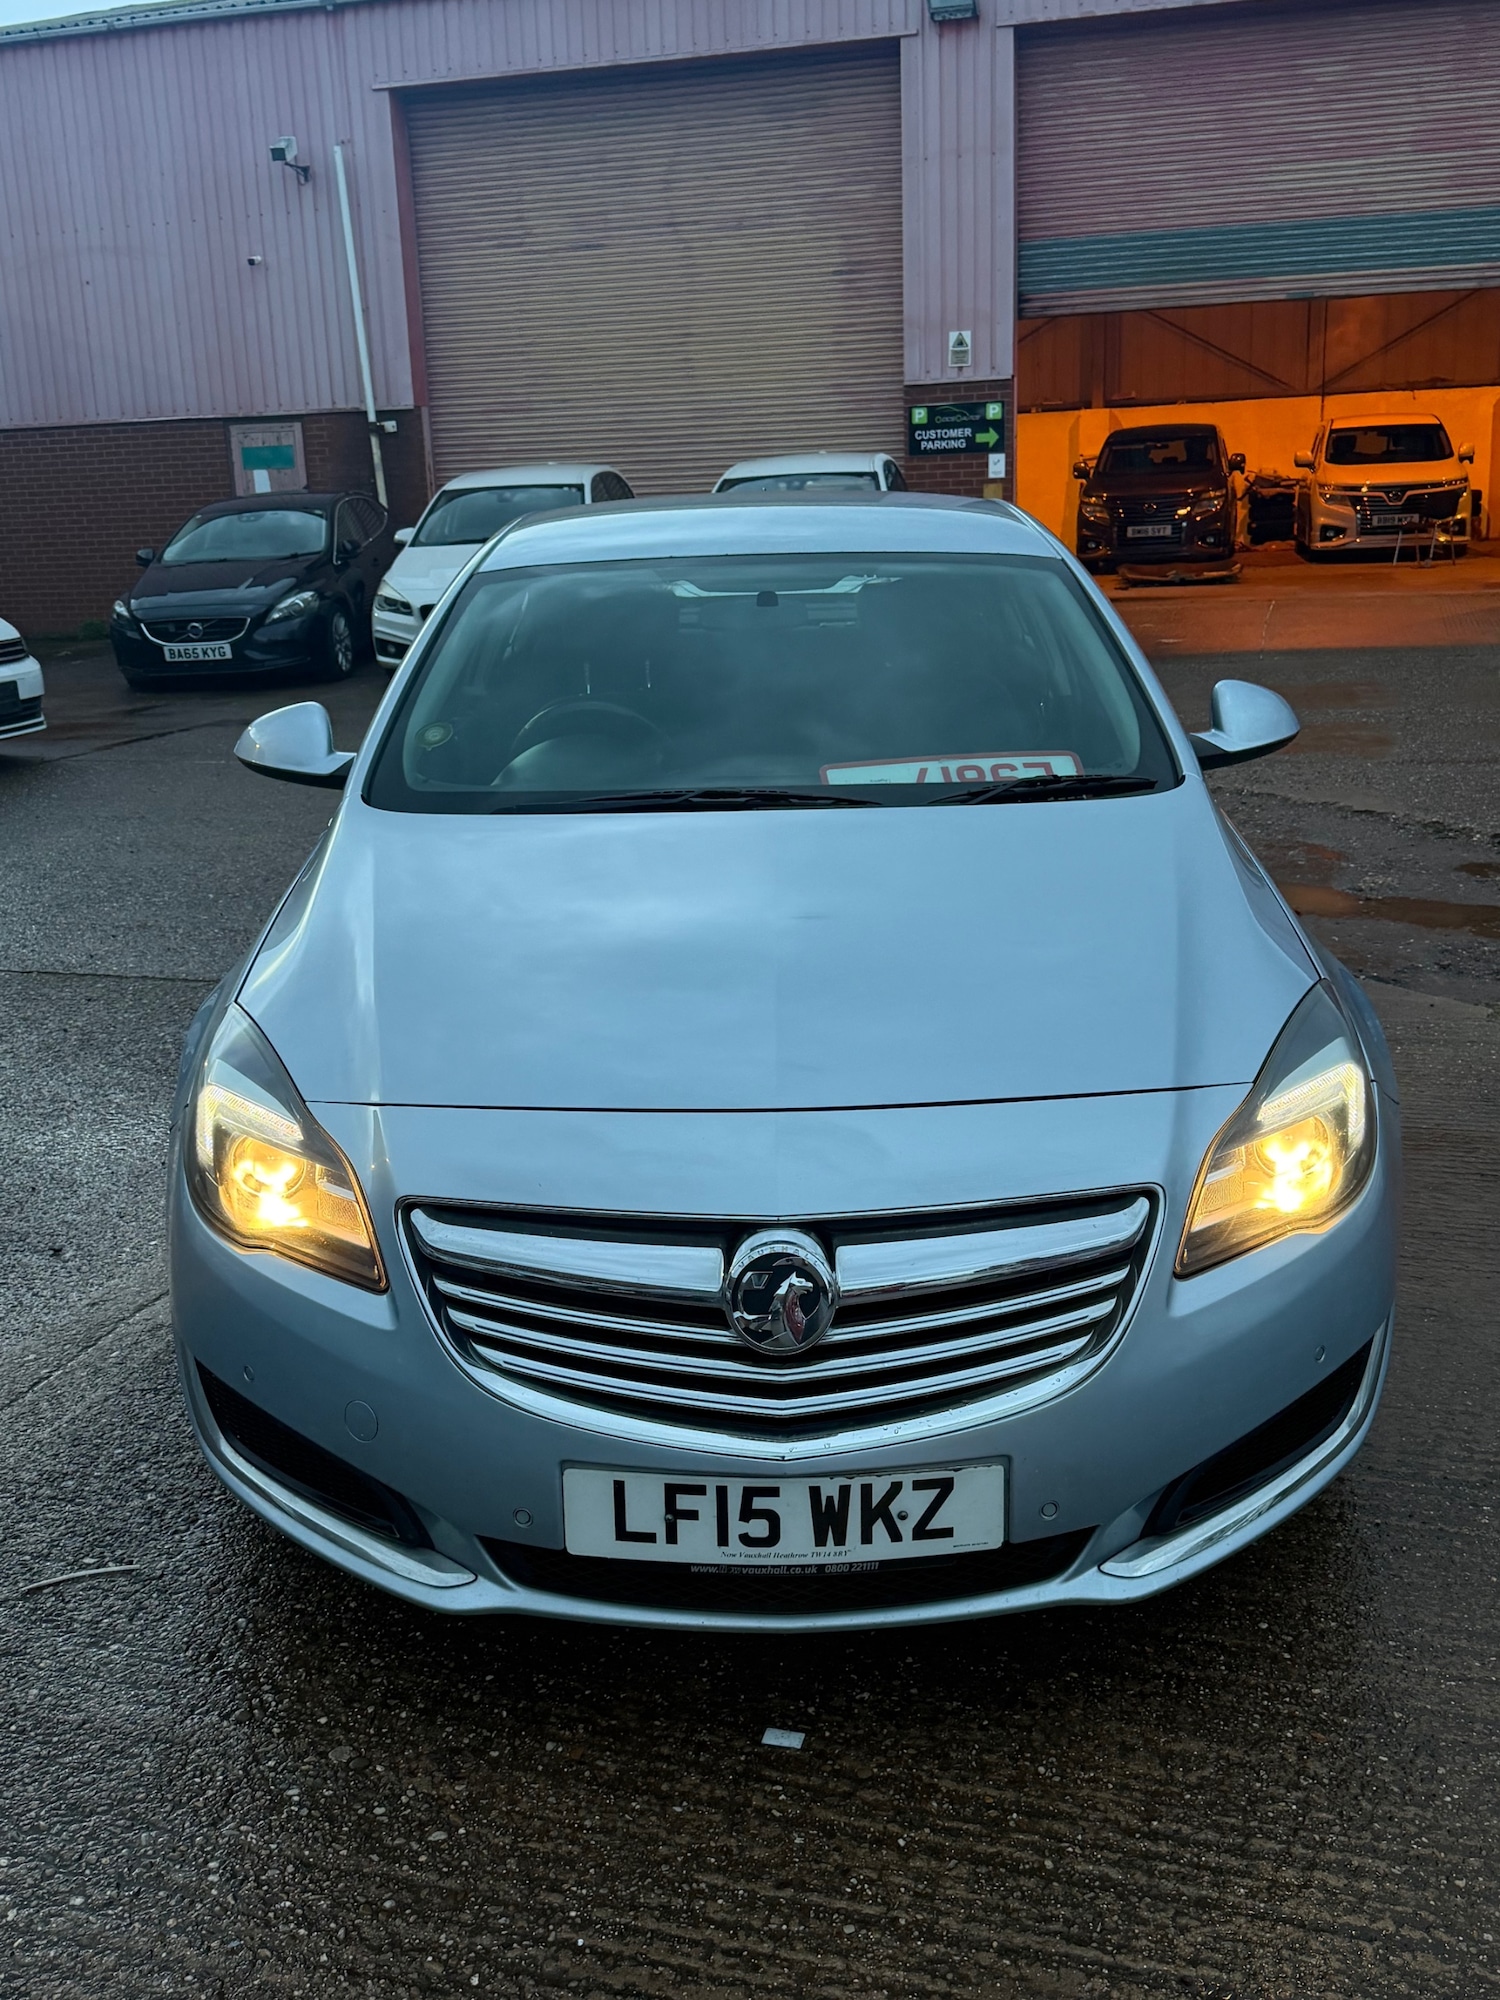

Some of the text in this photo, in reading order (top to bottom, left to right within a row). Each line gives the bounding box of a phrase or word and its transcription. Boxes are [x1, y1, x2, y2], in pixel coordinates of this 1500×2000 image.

[914, 427, 972, 441] CUSTOMER
[920, 439, 967, 451] PARKING
[1151, 526, 1167, 536] SVT
[168, 646, 226, 660] BA65 KYG
[738, 1245, 820, 1268] VAUXHALL
[613, 1477, 955, 1548] LF15 WKZ
[739, 1551, 772, 1559] Vauxhall
[773, 1551, 809, 1559] Heathrow
[824, 1563, 850, 1573] 0800
[851, 1561, 880, 1572] 221111
